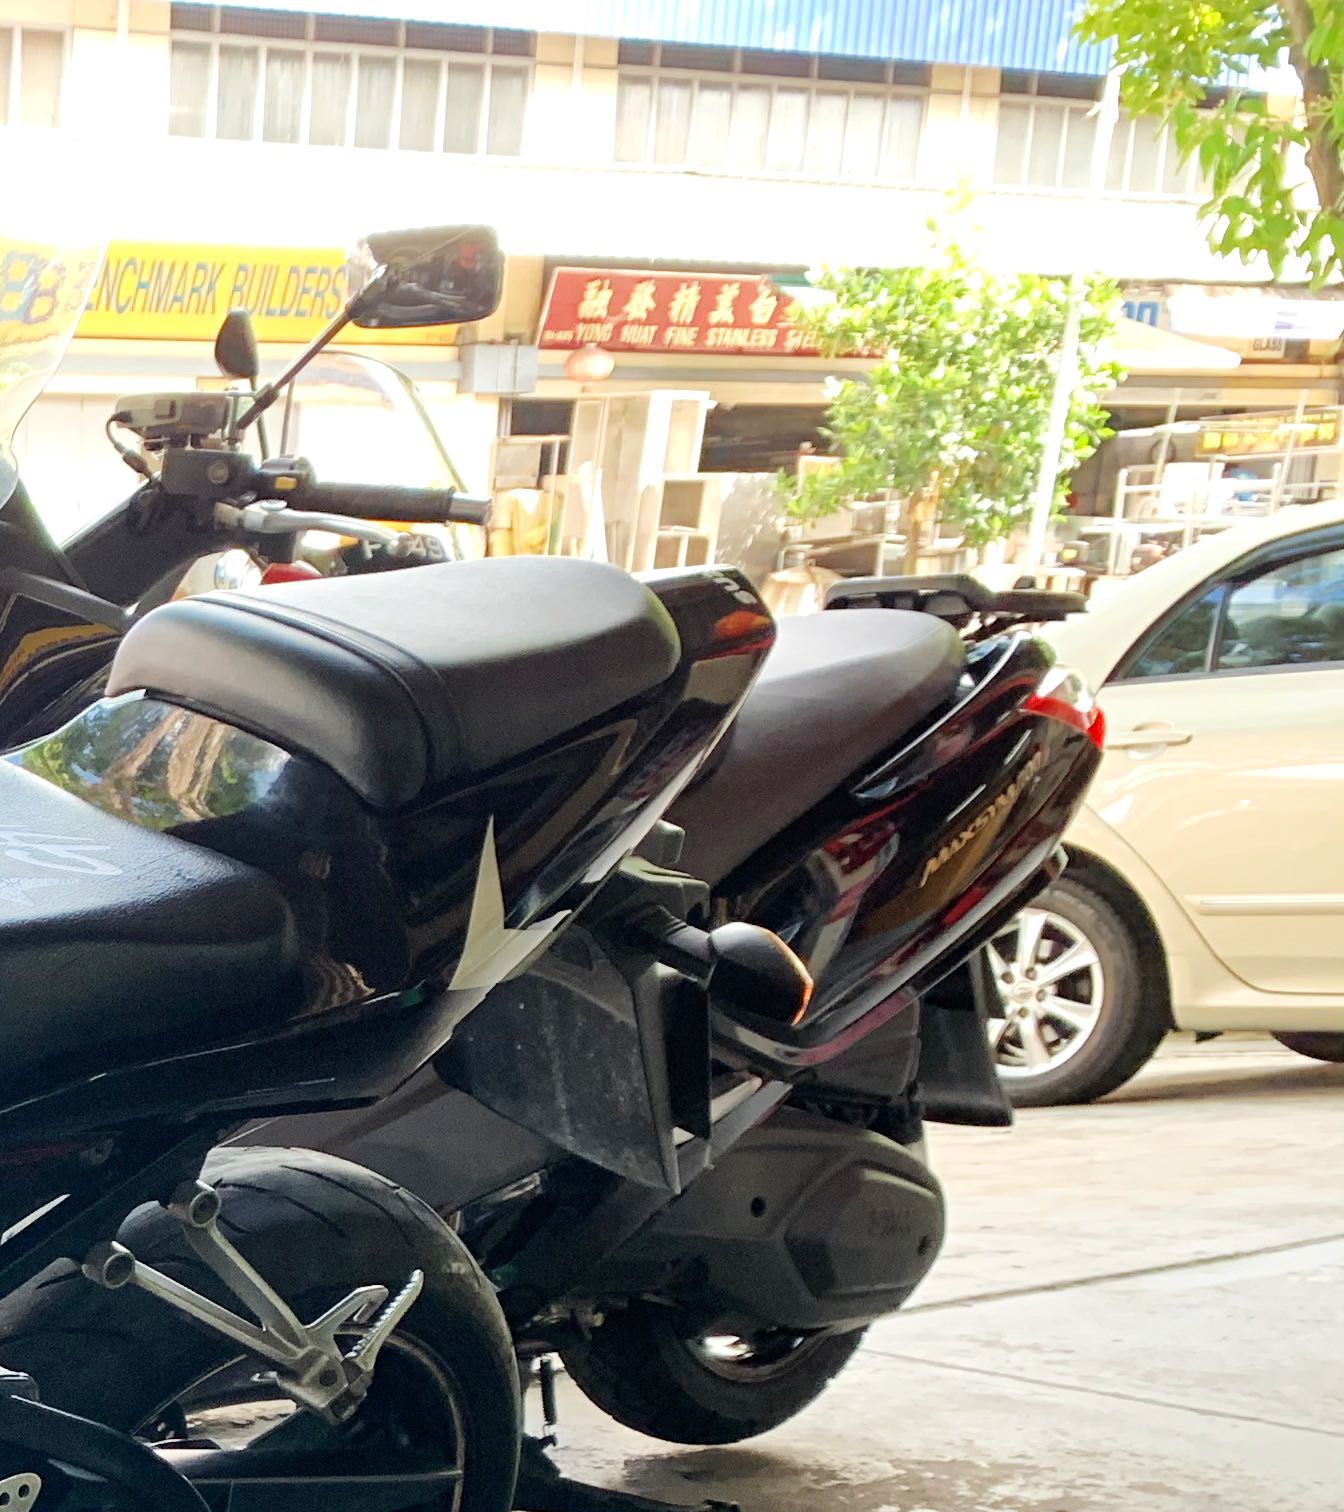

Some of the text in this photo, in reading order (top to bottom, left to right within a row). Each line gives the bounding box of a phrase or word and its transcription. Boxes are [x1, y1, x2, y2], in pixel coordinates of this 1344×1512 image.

[228, 263, 348, 320] BUILDERS
[663, 326, 699, 348] FINE
[705, 327, 779, 350] STAINLESS
